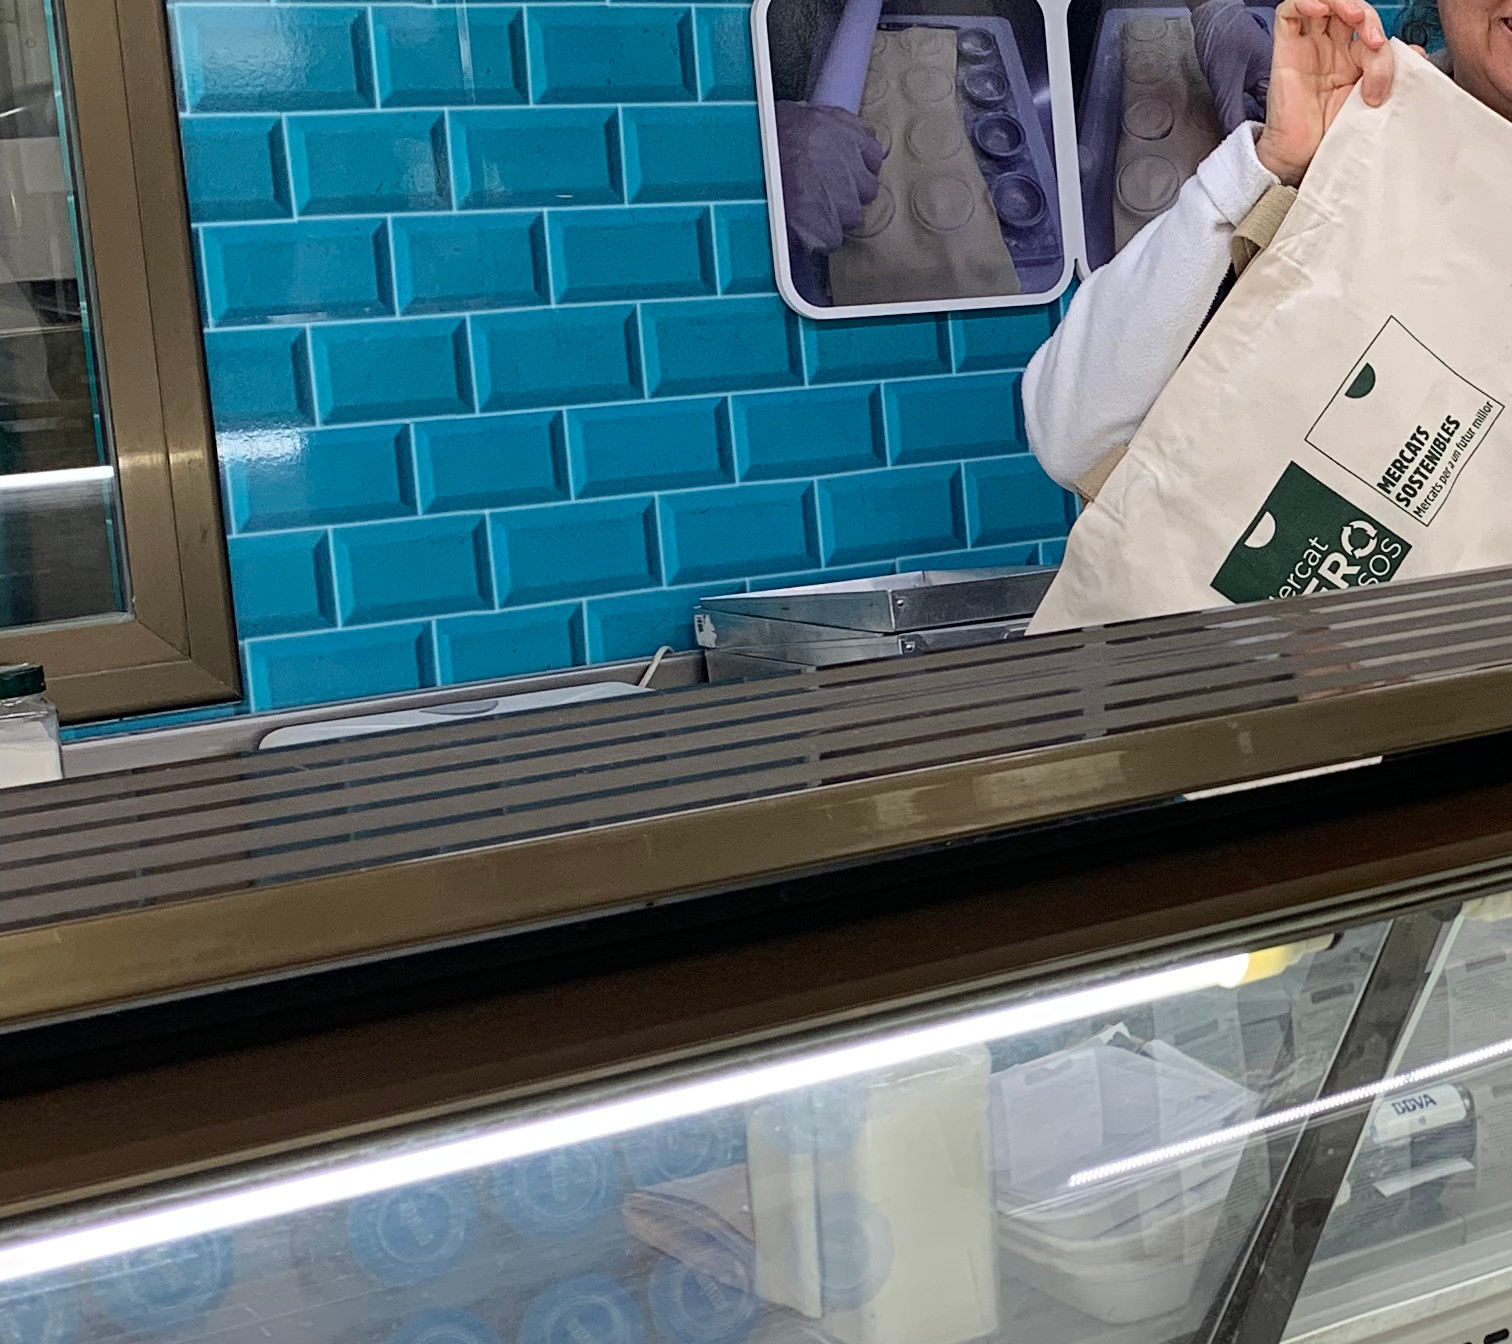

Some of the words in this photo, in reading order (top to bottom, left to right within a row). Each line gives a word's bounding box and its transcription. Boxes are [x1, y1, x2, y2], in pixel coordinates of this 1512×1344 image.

[1471, 400, 1494, 430] millor
[1455, 427, 1476, 452] futur
[1376, 425, 1430, 495] MERCATS
[1395, 415, 1461, 508] SOSTENIBLES
[1447, 460, 1456, 470] a
[1450, 449, 1462, 463] un
[1438, 466, 1452, 485] per
[1413, 482, 1443, 518] Mercats
[1269, 536, 1329, 601] ercat
